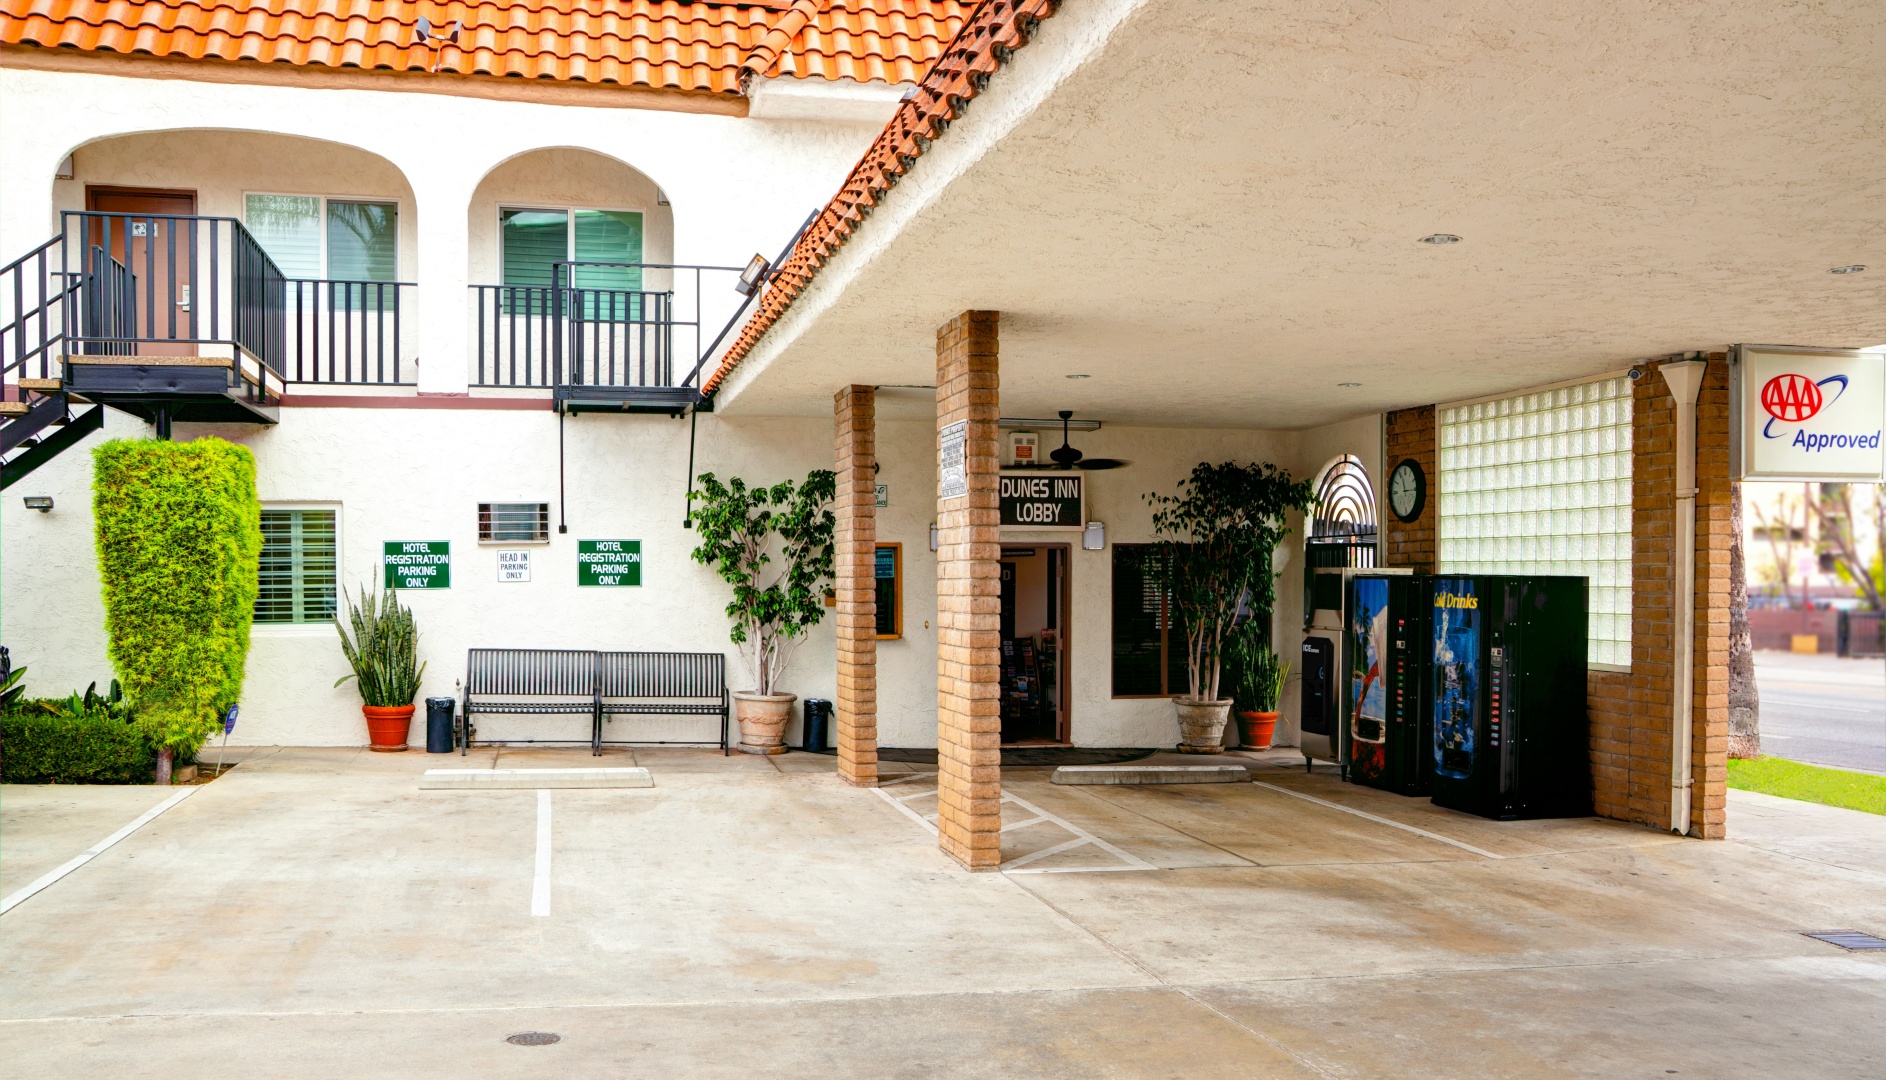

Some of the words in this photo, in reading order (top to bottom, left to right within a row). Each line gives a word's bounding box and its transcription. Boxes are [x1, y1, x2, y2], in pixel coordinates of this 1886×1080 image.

[1761, 374, 1822, 422] AAA
[1792, 429, 1881, 453] Approved
[1001, 479, 1050, 498] DUNES
[1054, 479, 1078, 499] INN
[1016, 502, 1062, 523] LOBBY
[403, 543, 430, 552] HOTEL
[596, 542, 622, 551] HOTEL
[385, 554, 448, 564] REGISTRATION
[500, 552, 518, 562] HEAD
[520, 552, 528, 562] IN
[579, 553, 639, 562] REGISTRATION
[398, 566, 436, 575] PARKING
[500, 563, 528, 571] PARKING
[591, 564, 628, 573] PARKING
[506, 571, 523, 579] ONLY
[406, 578, 429, 587] ONLY
[598, 576, 620, 585] ONLY
[1434, 592, 1446, 608] Cold
[1446, 592, 1478, 608] Drinks
